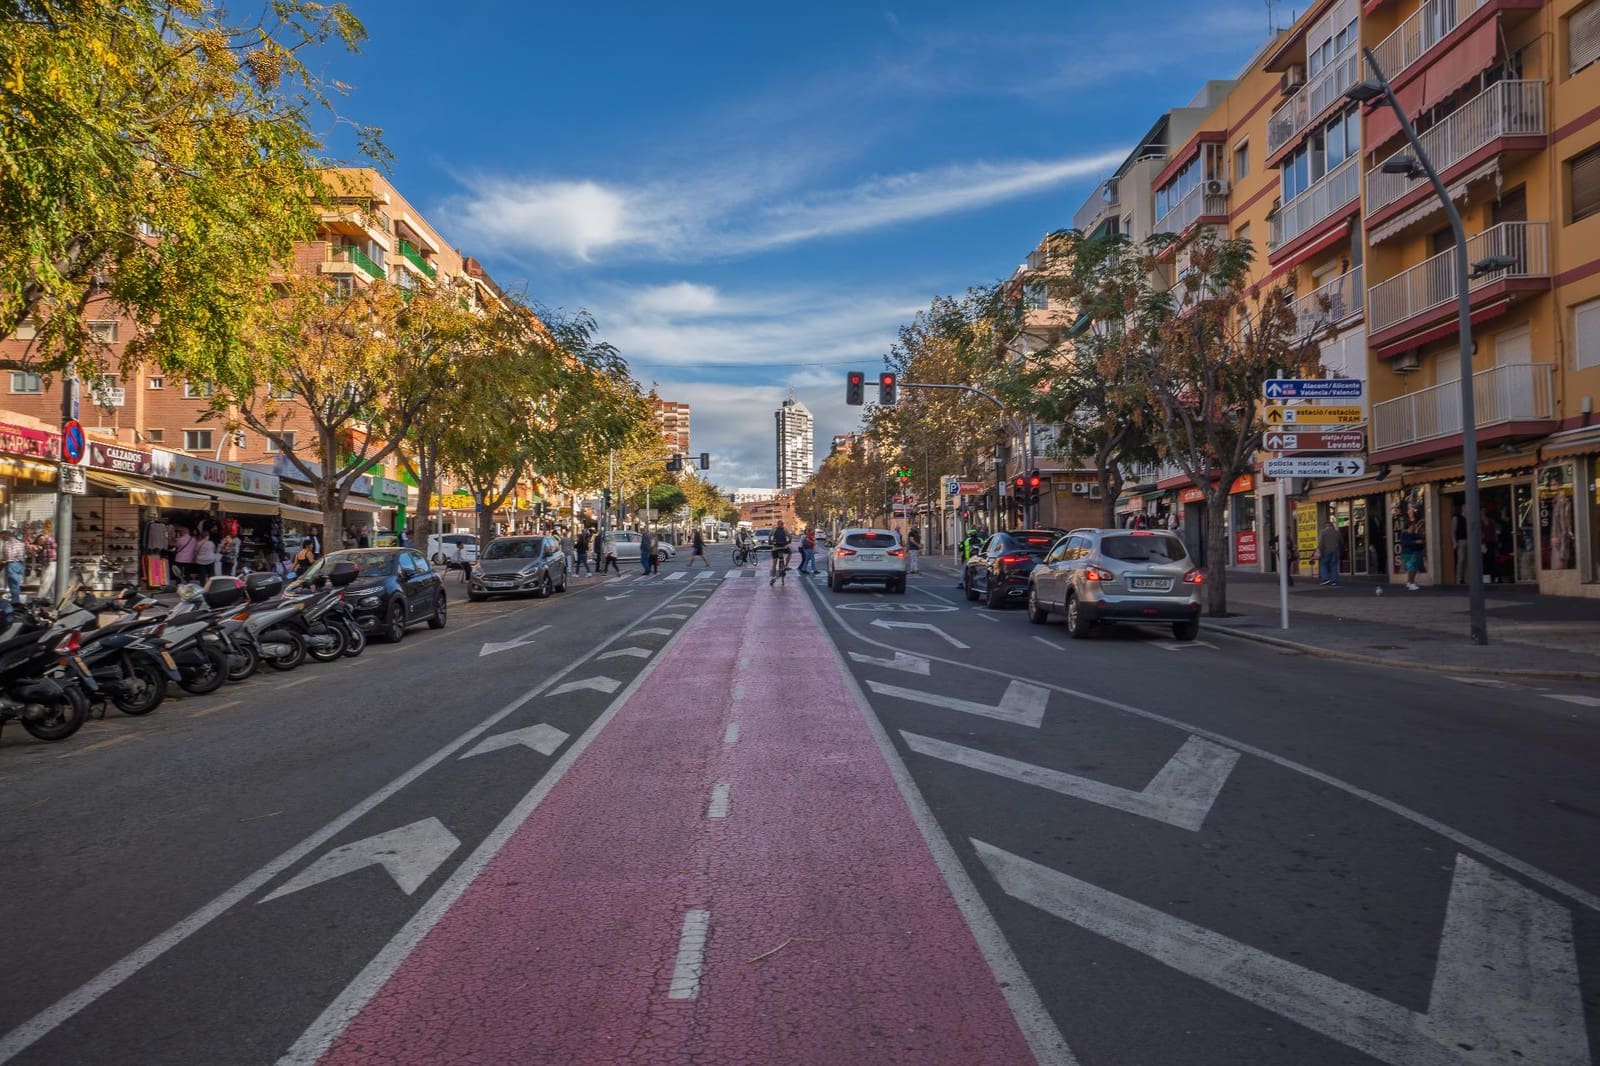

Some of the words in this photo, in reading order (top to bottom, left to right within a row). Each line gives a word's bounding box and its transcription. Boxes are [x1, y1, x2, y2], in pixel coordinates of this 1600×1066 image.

[106, 447, 142, 463] CALZADOS
[111, 459, 136, 472] SHOES
[203, 466, 226, 484] JAILO
